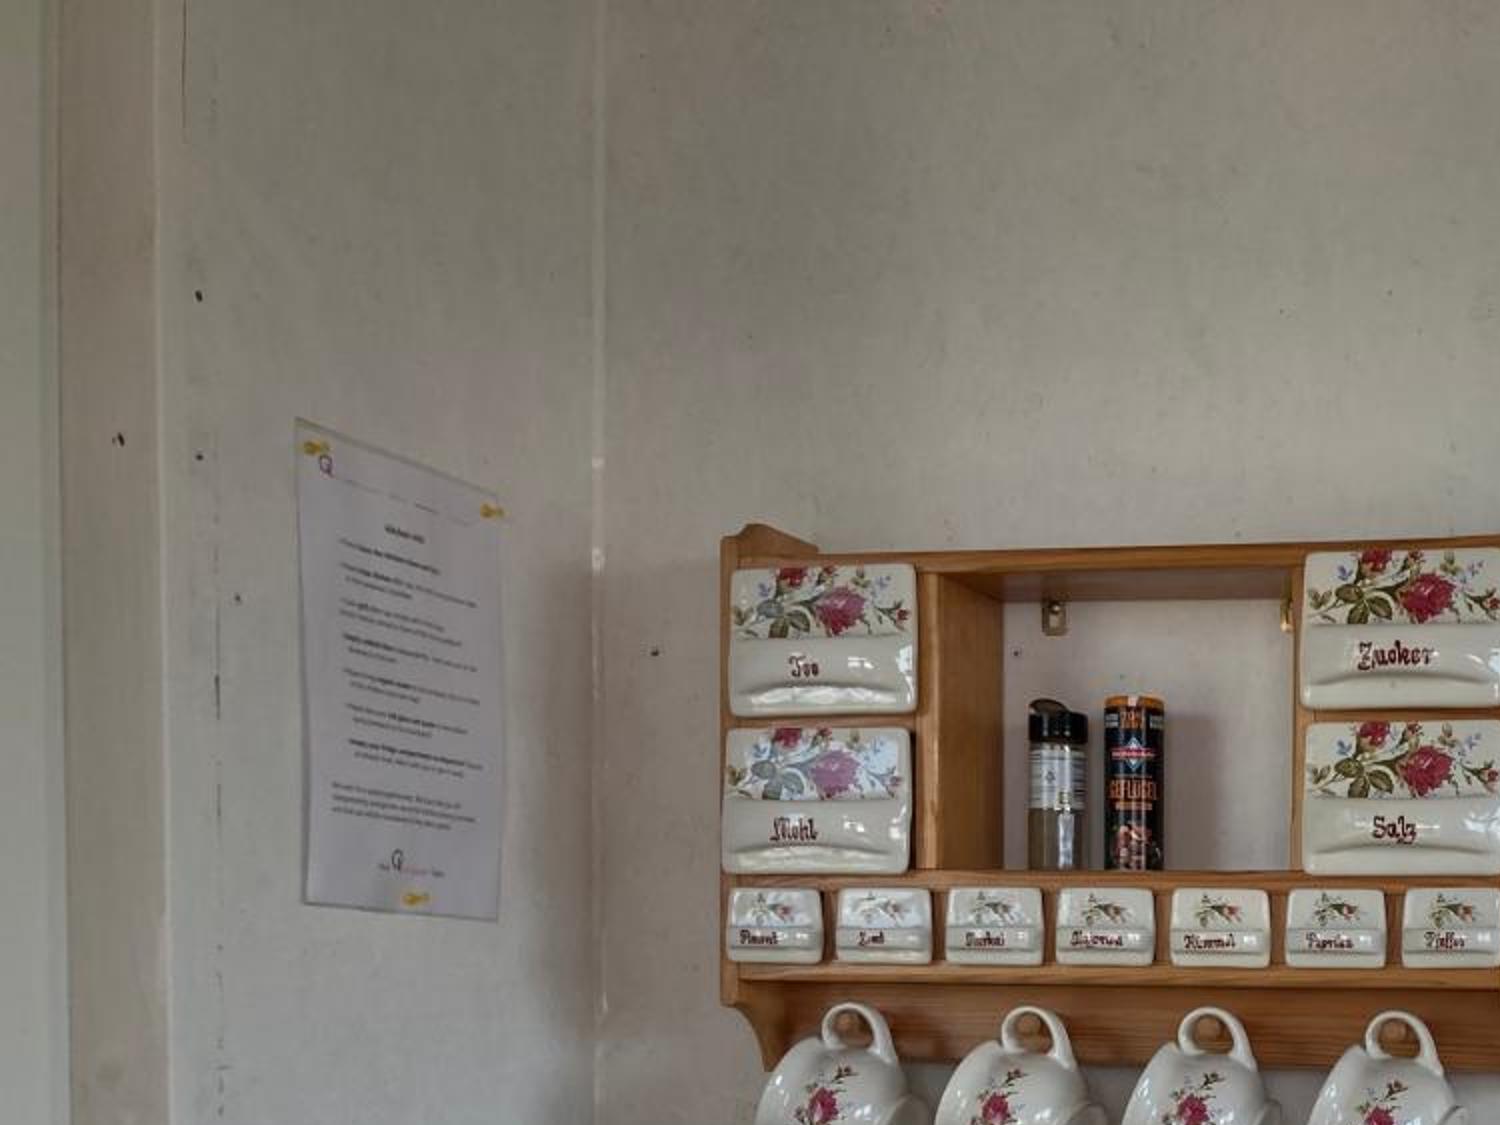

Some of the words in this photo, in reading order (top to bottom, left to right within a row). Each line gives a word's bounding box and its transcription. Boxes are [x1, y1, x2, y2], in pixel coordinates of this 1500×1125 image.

[789, 655, 819, 678] Tee
[1358, 640, 1434, 670] Zucker
[769, 816, 818, 841] Mehl
[1373, 815, 1417, 845] Salz
